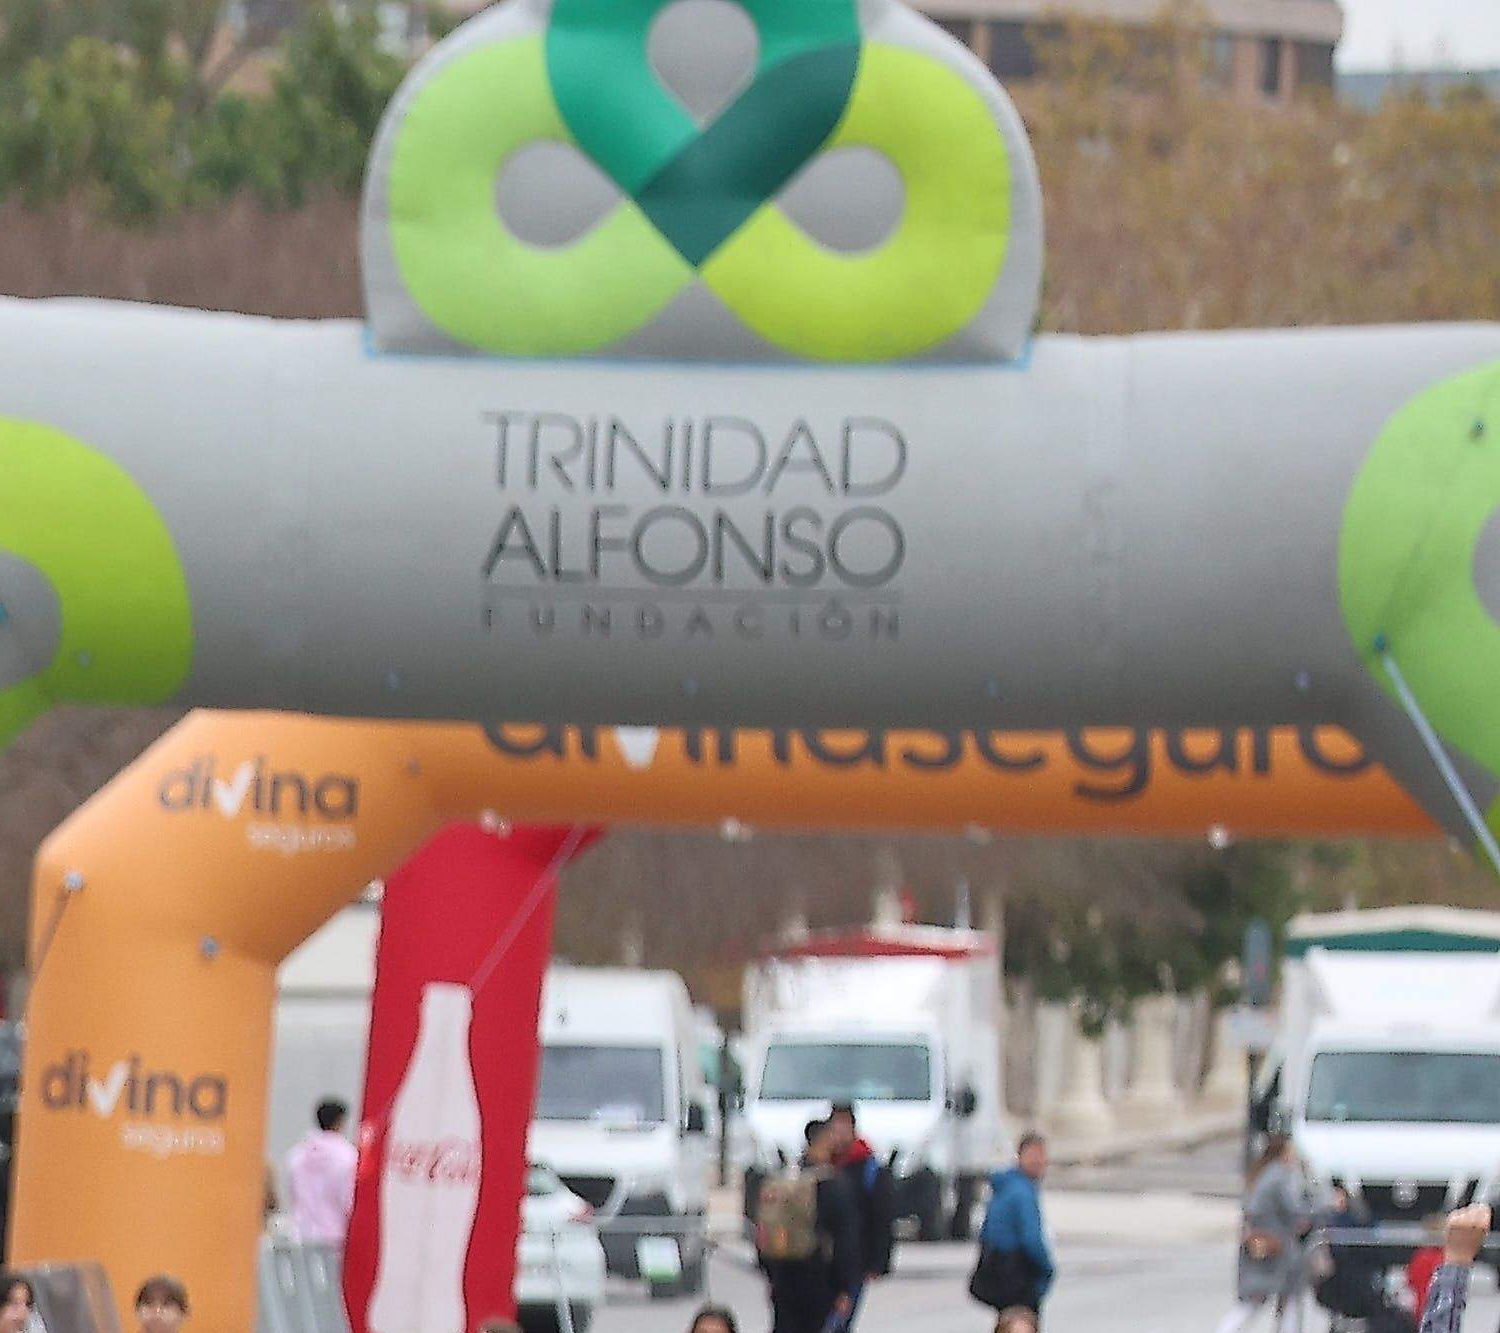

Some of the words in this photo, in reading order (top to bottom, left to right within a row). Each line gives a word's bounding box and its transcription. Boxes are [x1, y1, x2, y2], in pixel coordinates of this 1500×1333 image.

[480, 411, 908, 497] TRINIDAD
[482, 504, 907, 588] ALFONSO
[158, 752, 360, 818] divina
[40, 1050, 228, 1120] divina
